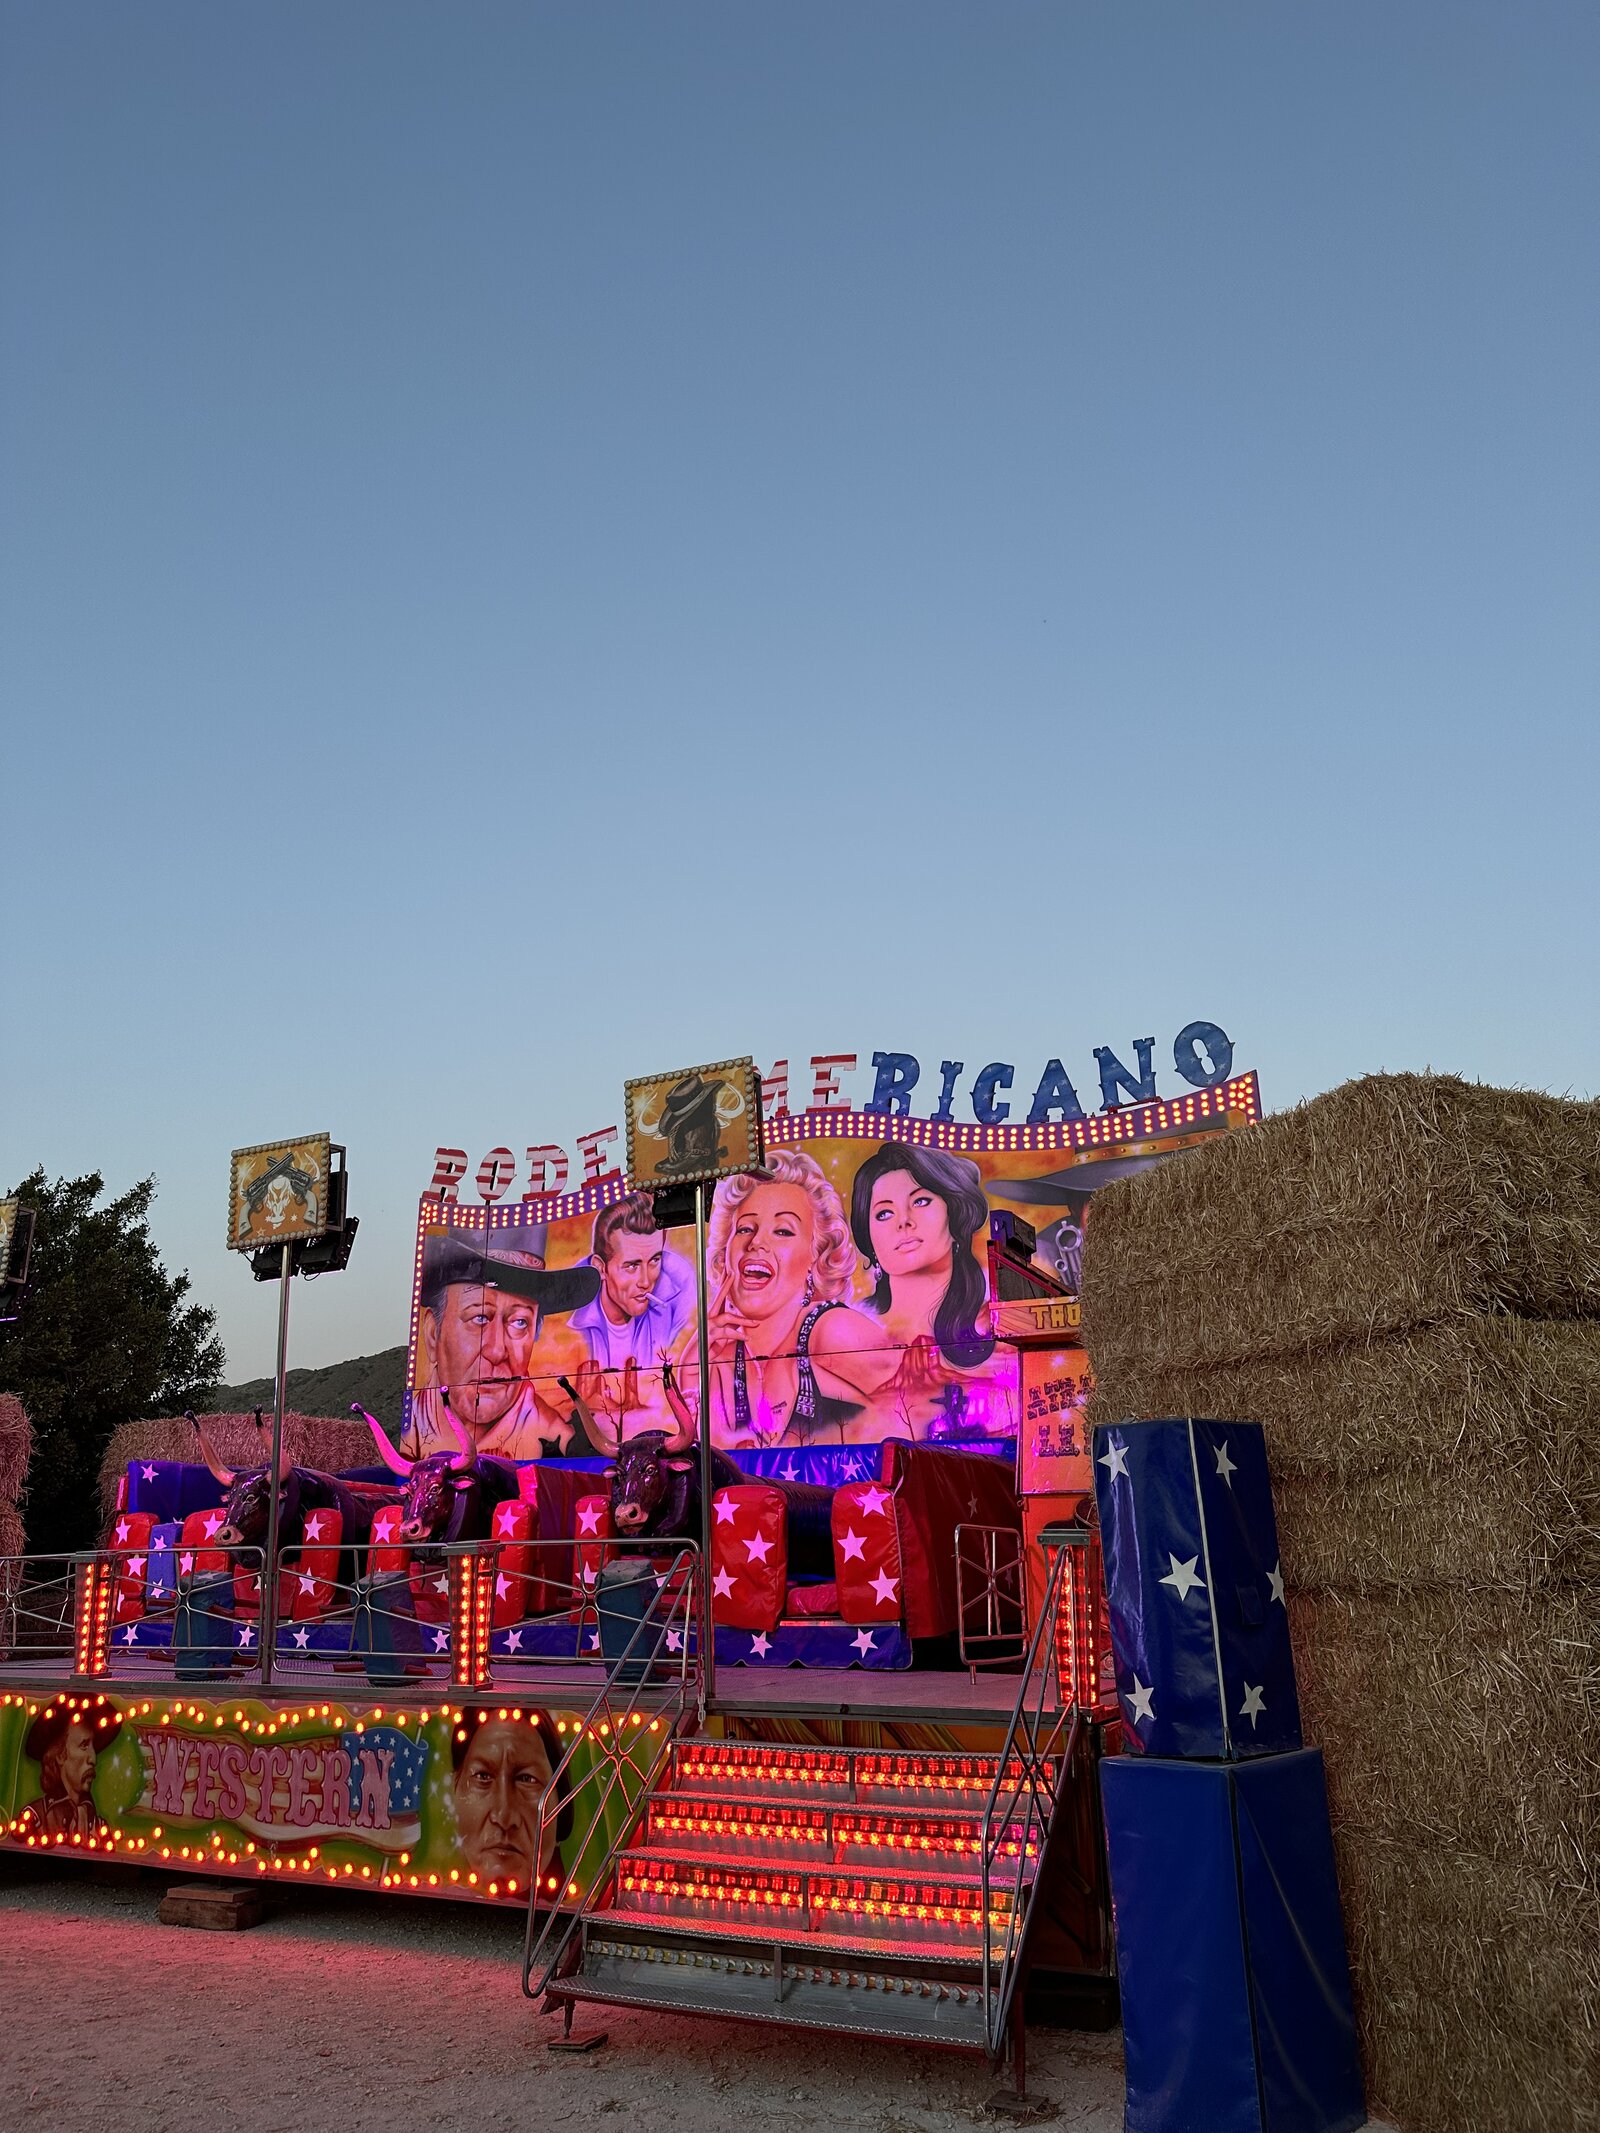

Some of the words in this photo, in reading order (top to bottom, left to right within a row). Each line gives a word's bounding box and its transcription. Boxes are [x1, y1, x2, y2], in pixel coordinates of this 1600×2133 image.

[421, 1125, 622, 1206] RODE
[752, 1020, 1236, 1125] MERICANO
[147, 1734, 396, 1830] WESTERN
